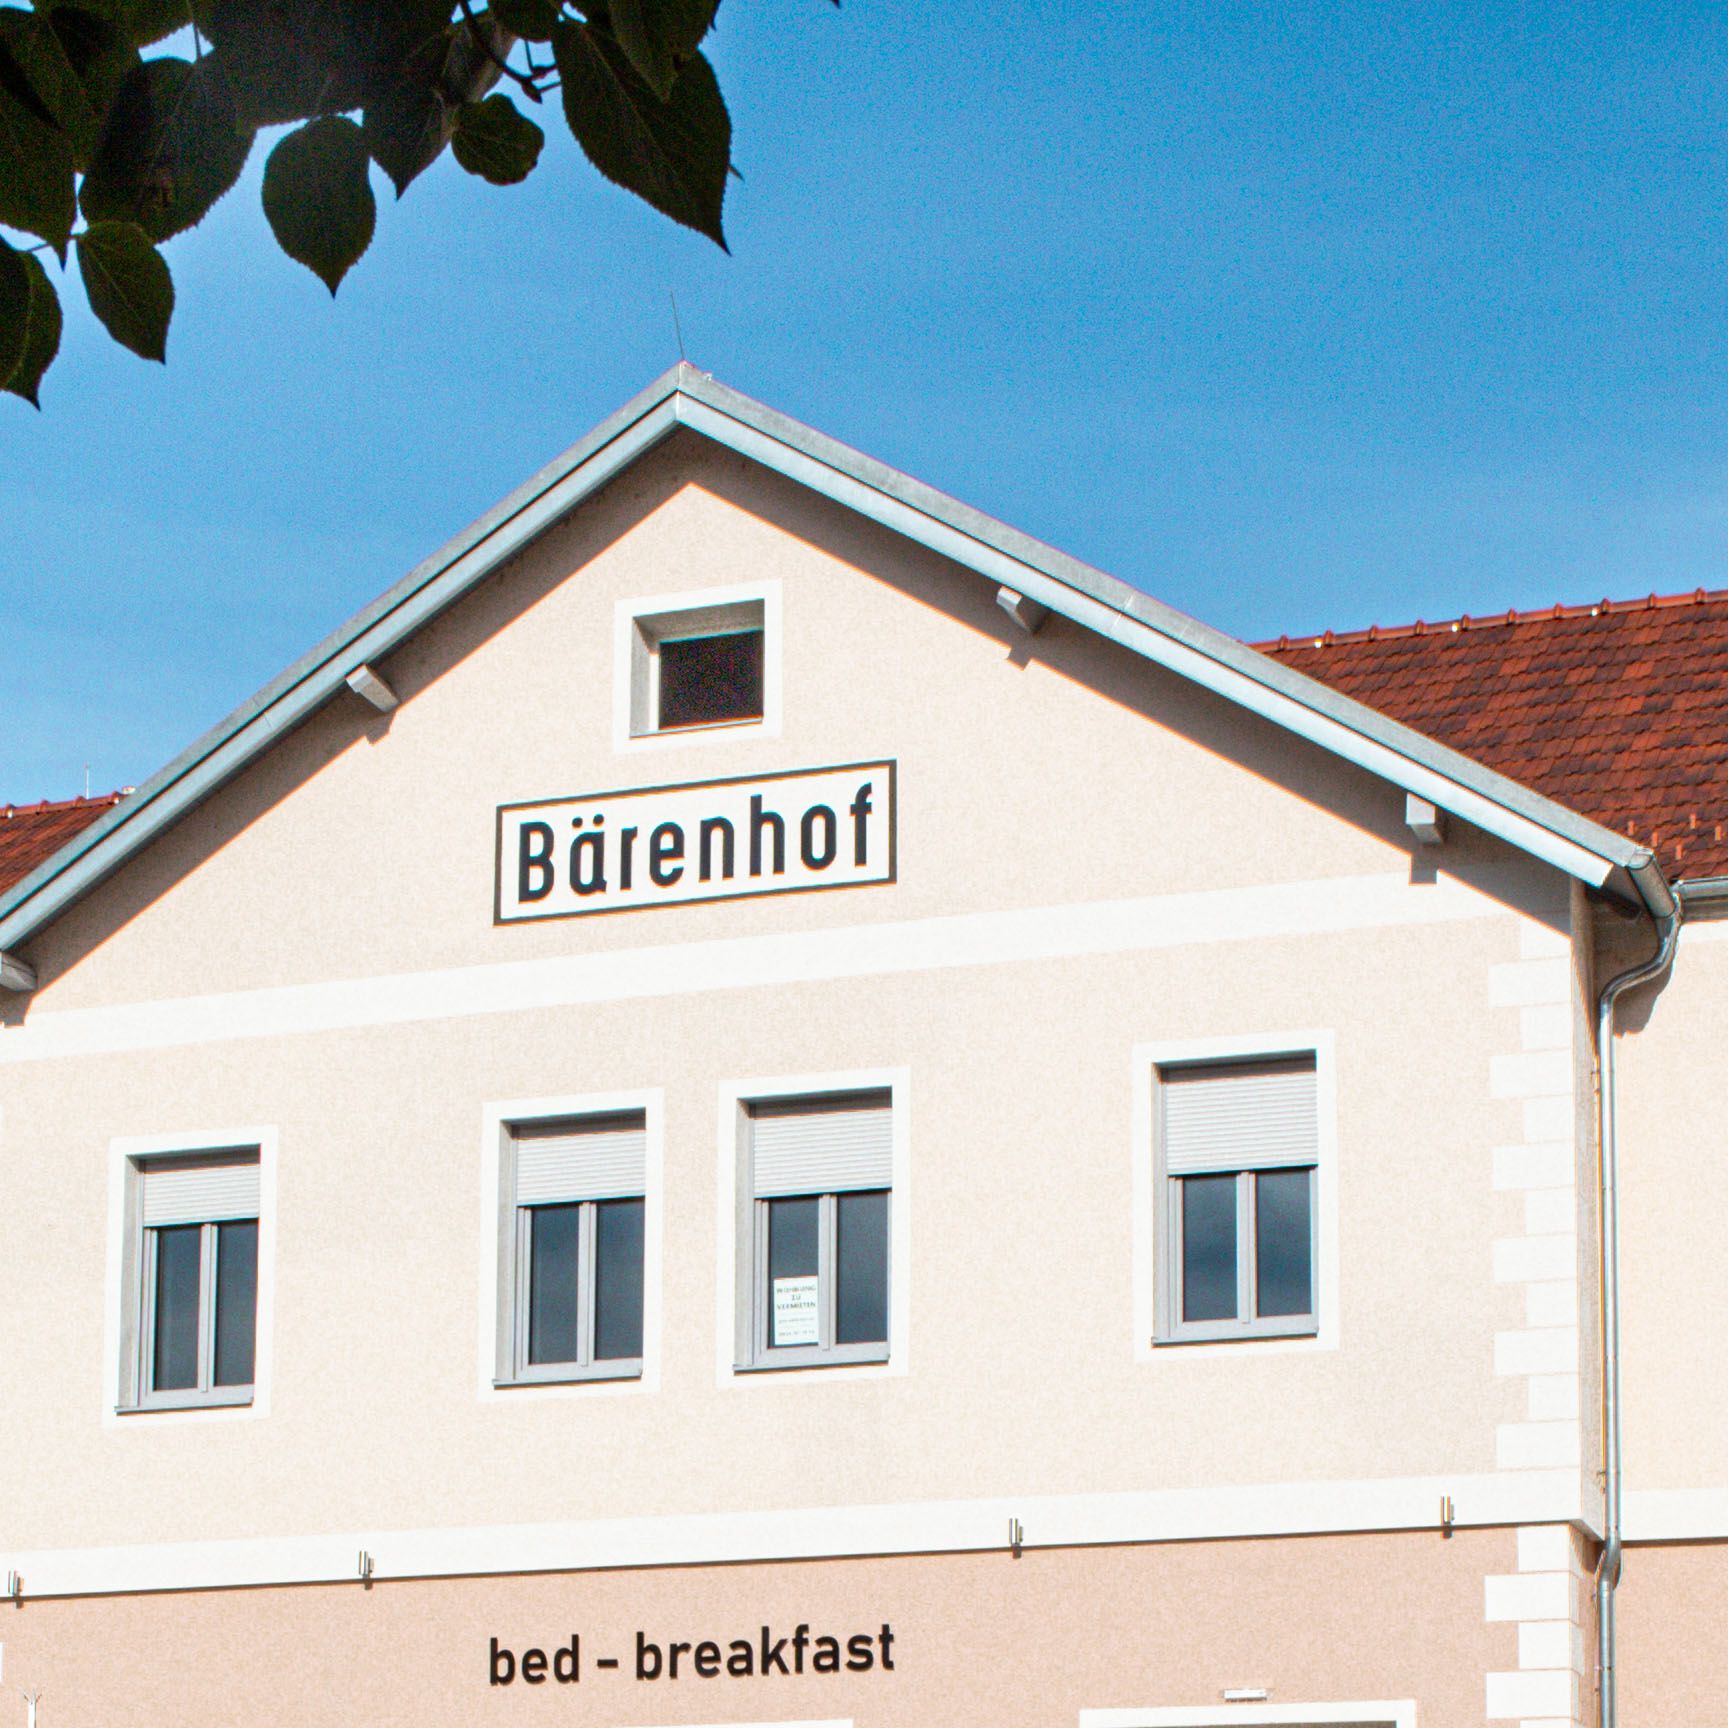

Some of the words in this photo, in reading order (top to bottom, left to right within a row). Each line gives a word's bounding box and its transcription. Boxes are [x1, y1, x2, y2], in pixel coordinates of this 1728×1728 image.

[517, 781, 874, 905] Bärenhof
[489, 1633, 581, 1686] bed
[635, 1622, 897, 1682] breakfast
